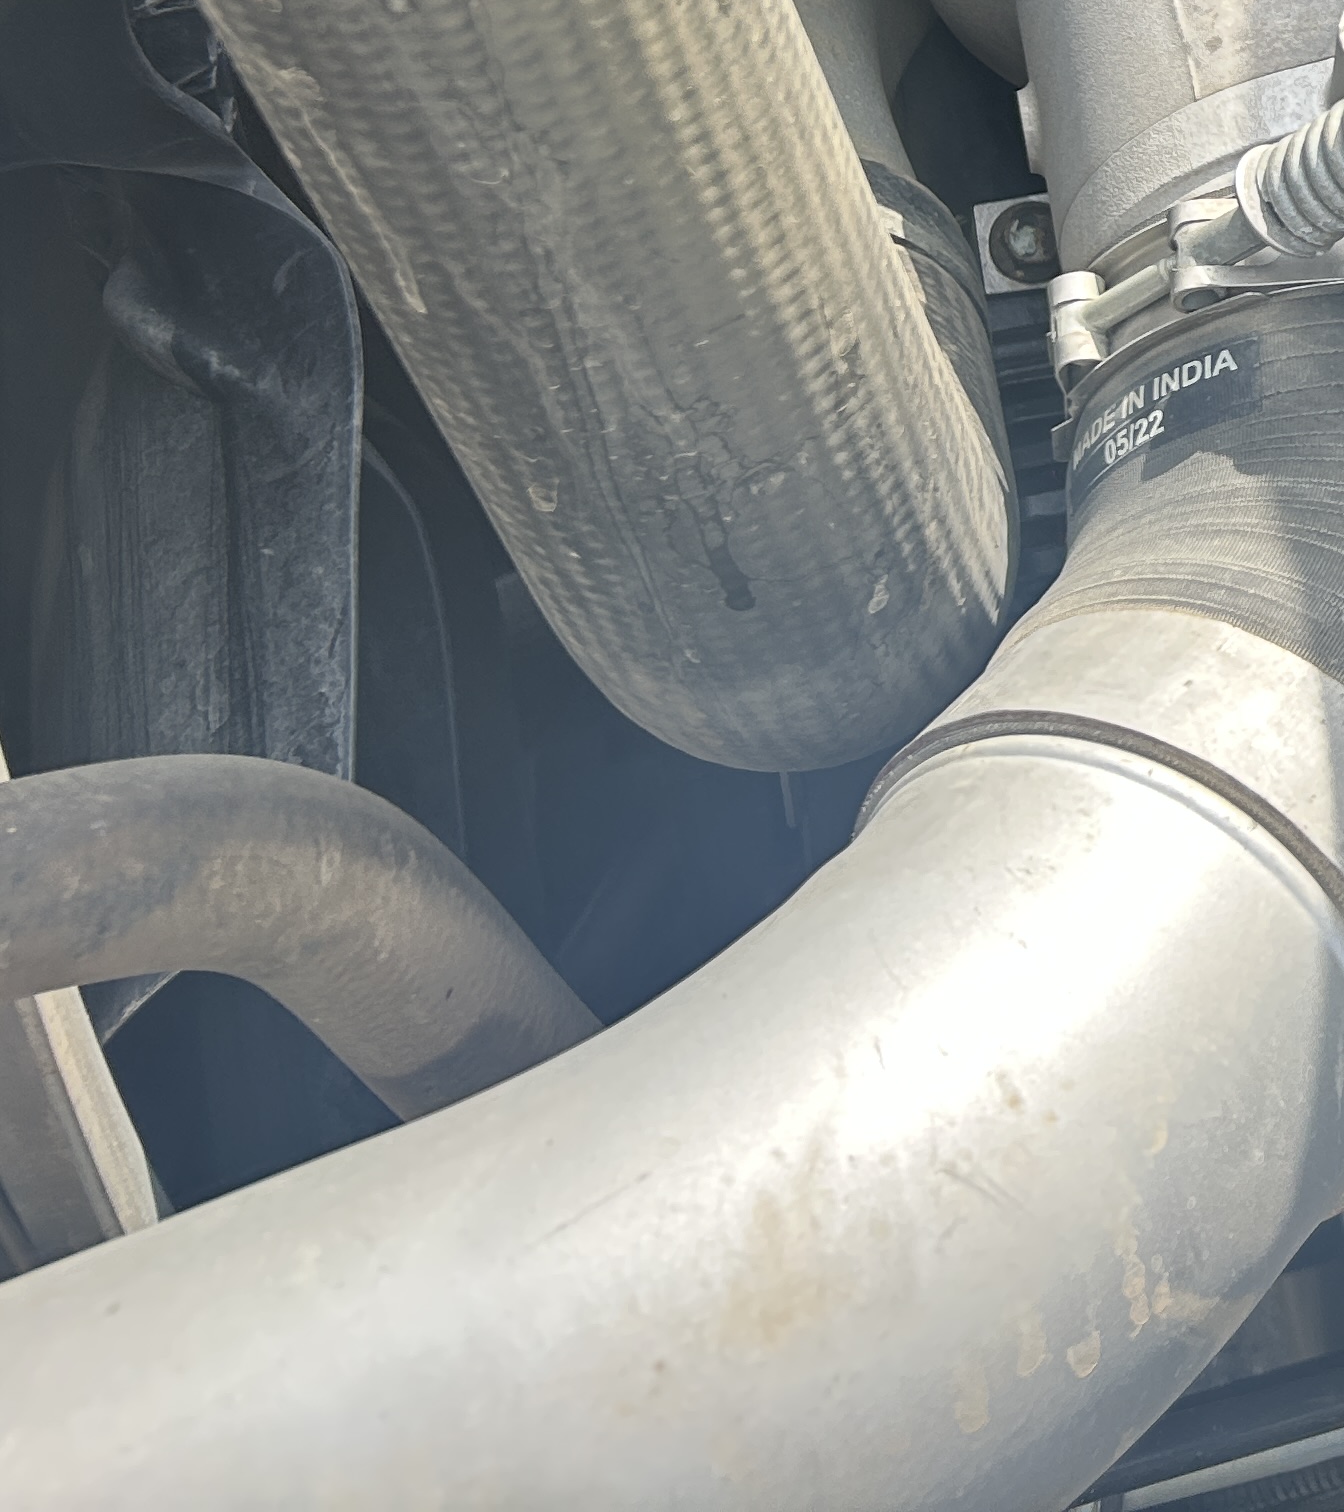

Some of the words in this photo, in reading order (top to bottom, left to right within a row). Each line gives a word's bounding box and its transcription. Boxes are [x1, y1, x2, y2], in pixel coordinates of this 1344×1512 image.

[1073, 404, 1117, 470] MADE
[1120, 385, 1145, 419] IN
[1152, 349, 1239, 401] INDIA
[1104, 409, 1165, 465] 05/22
